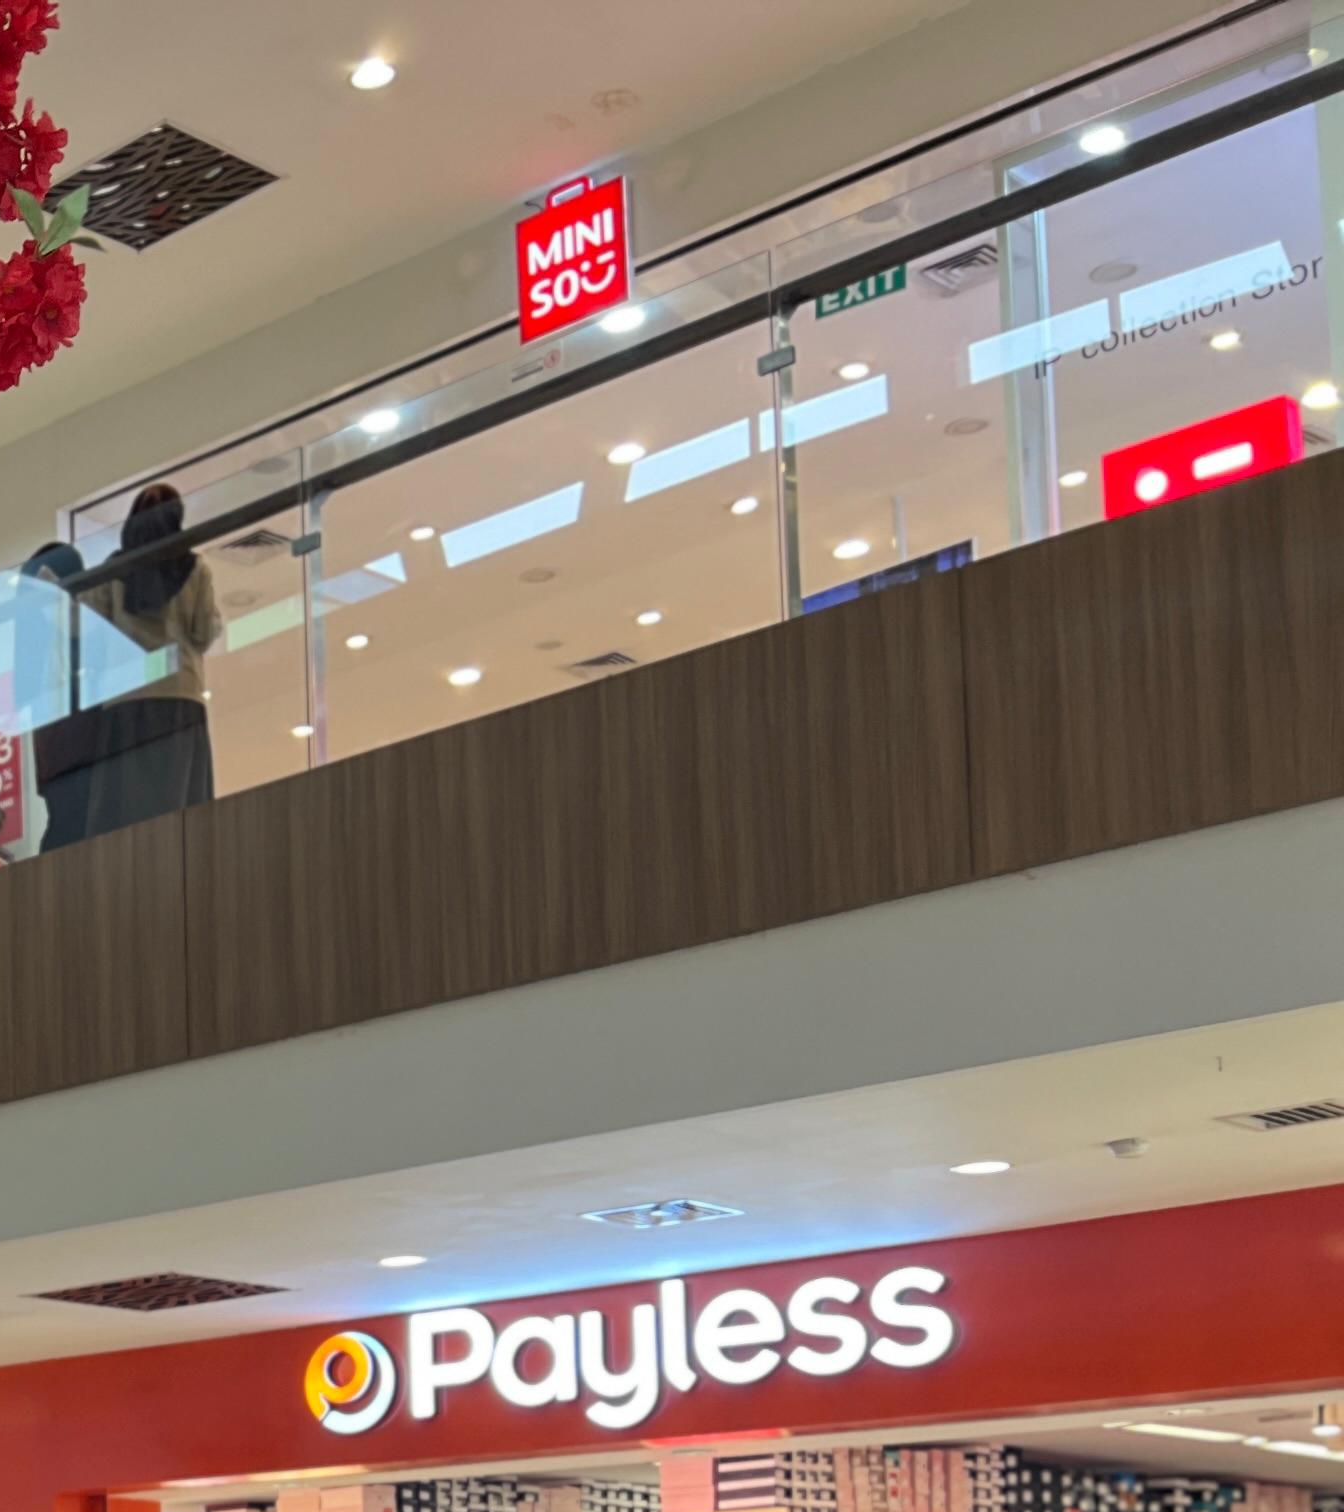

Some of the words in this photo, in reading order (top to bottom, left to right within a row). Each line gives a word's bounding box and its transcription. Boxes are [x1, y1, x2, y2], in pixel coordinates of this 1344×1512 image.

[527, 208, 614, 275] MINI
[821, 267, 899, 313] EXIT
[410, 1266, 956, 1429] Payless
